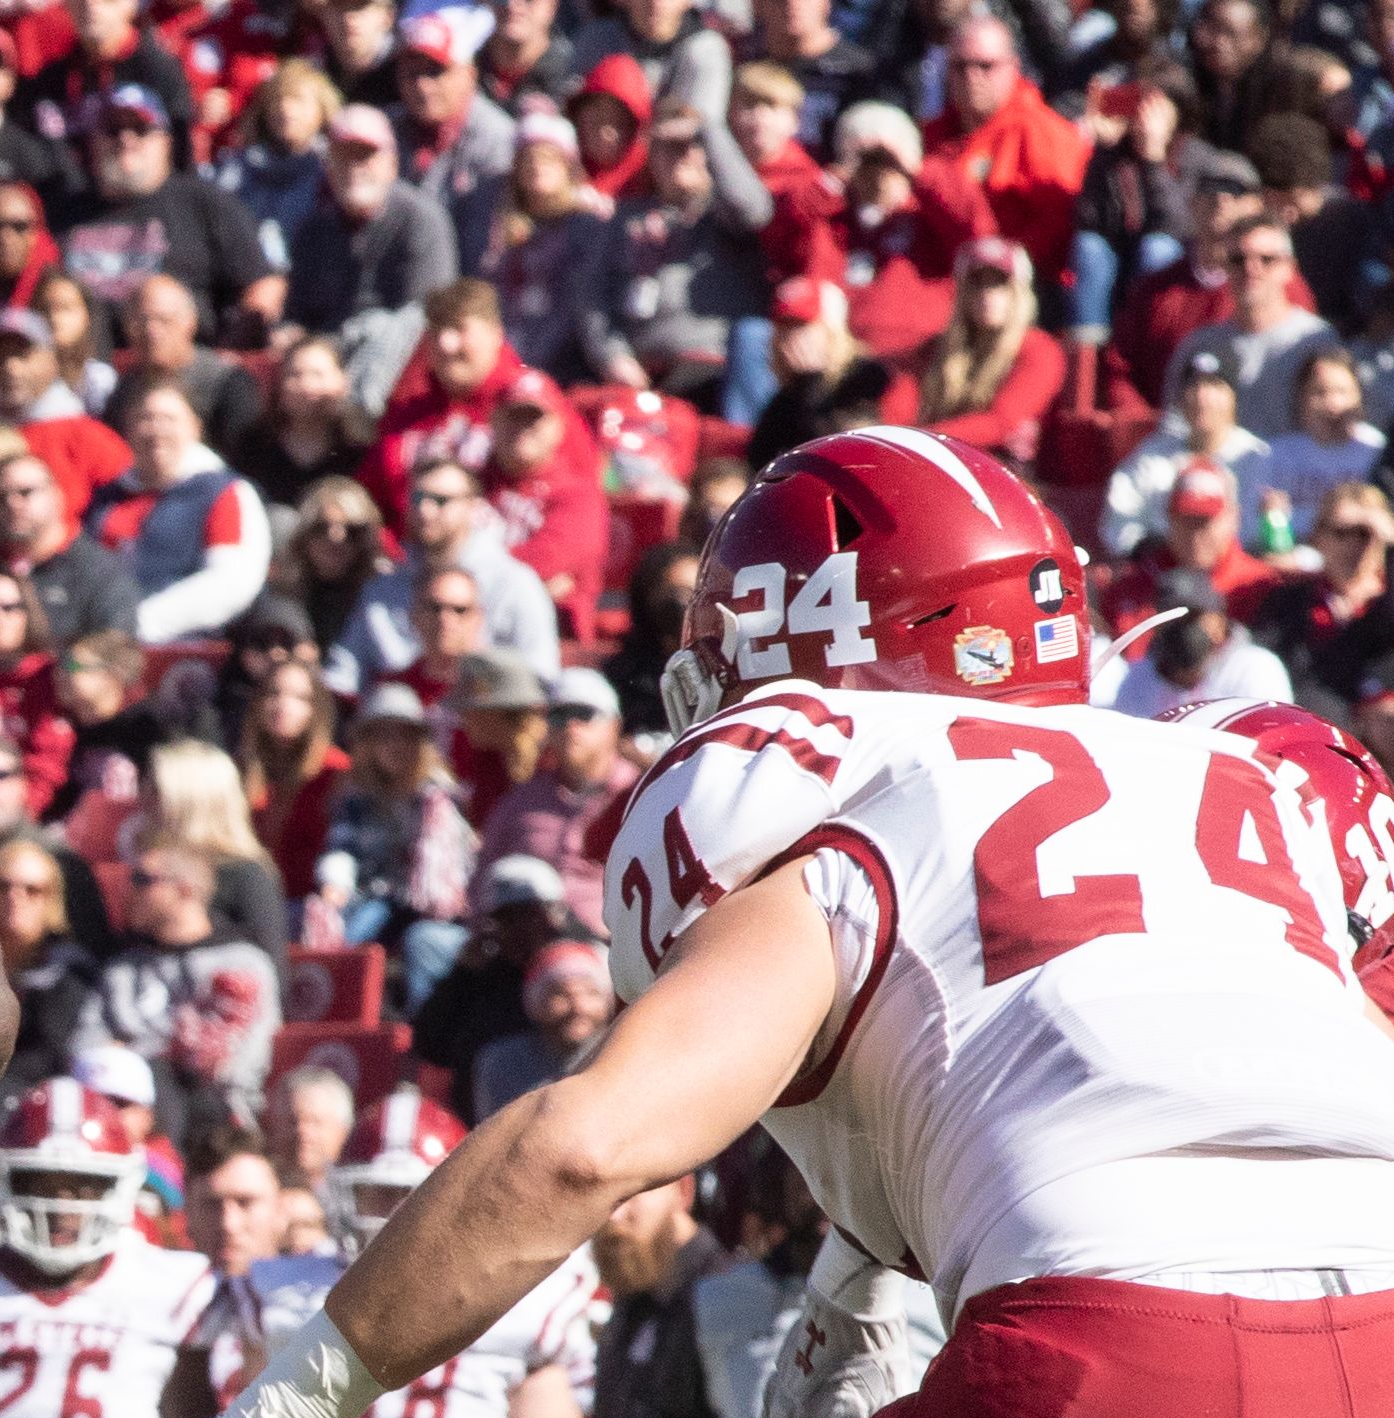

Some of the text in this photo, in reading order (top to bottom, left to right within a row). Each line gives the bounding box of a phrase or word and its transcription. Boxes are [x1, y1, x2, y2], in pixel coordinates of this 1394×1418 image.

[731, 551, 877, 680] 24
[622, 805, 728, 975] 24
[947, 716, 1345, 985] 24
